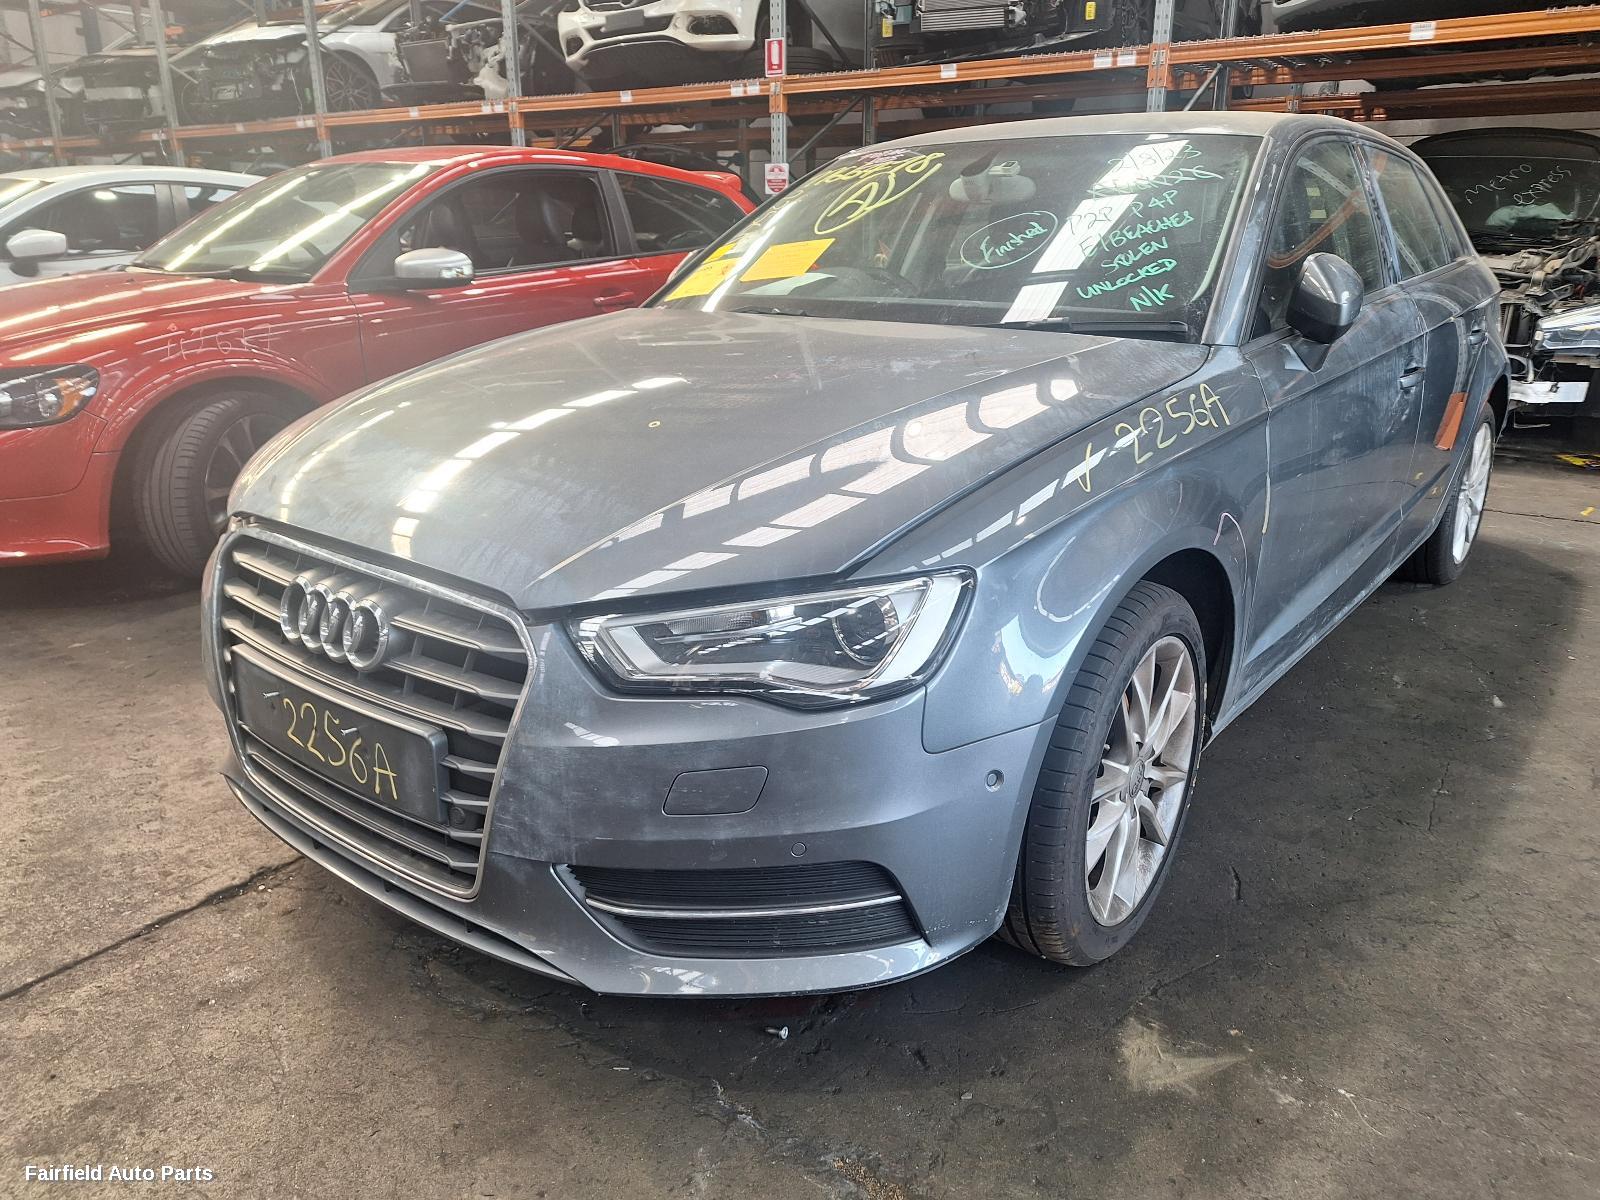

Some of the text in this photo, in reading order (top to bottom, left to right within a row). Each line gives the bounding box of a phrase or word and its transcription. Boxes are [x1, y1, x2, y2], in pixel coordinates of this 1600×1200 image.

[1076, 258, 1178, 300] UNLOCKED
[1129, 283, 1176, 312] N/K
[1114, 383, 1231, 465] 2256A
[282, 697, 398, 800] 2256A
